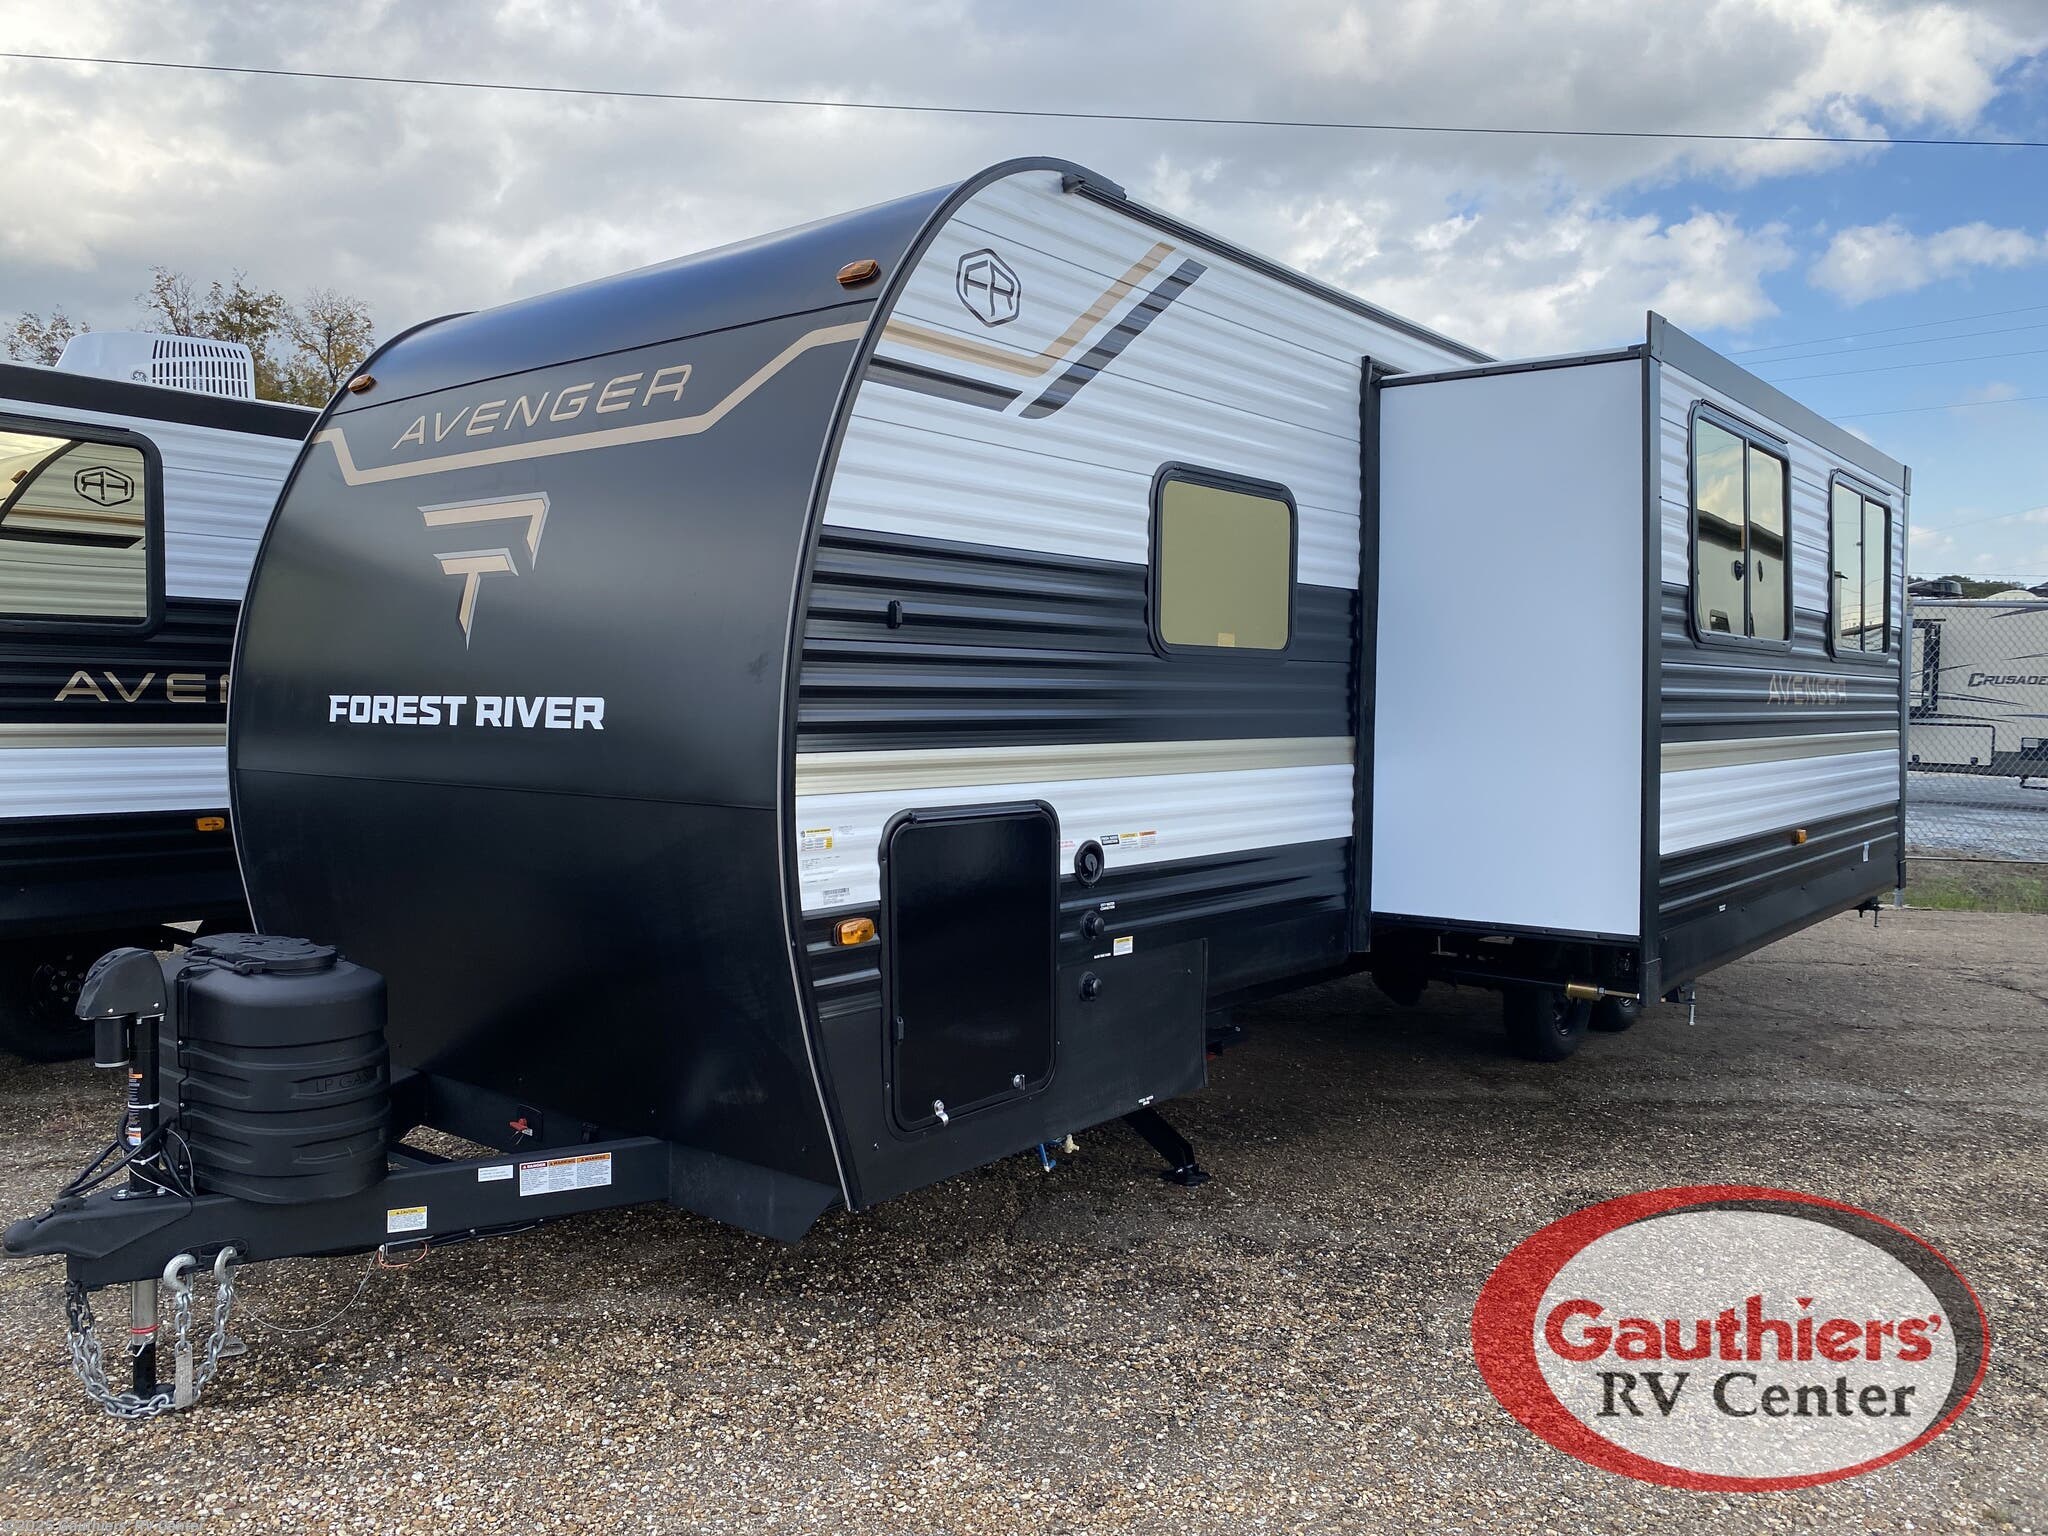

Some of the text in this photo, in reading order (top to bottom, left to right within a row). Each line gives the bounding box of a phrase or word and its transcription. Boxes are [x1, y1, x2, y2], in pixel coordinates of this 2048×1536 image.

[392, 364, 693, 450] AVENGER
[54, 670, 231, 703] AVE
[1766, 673, 1847, 705] AVENGER
[328, 695, 605, 730] FOREST RIVER
